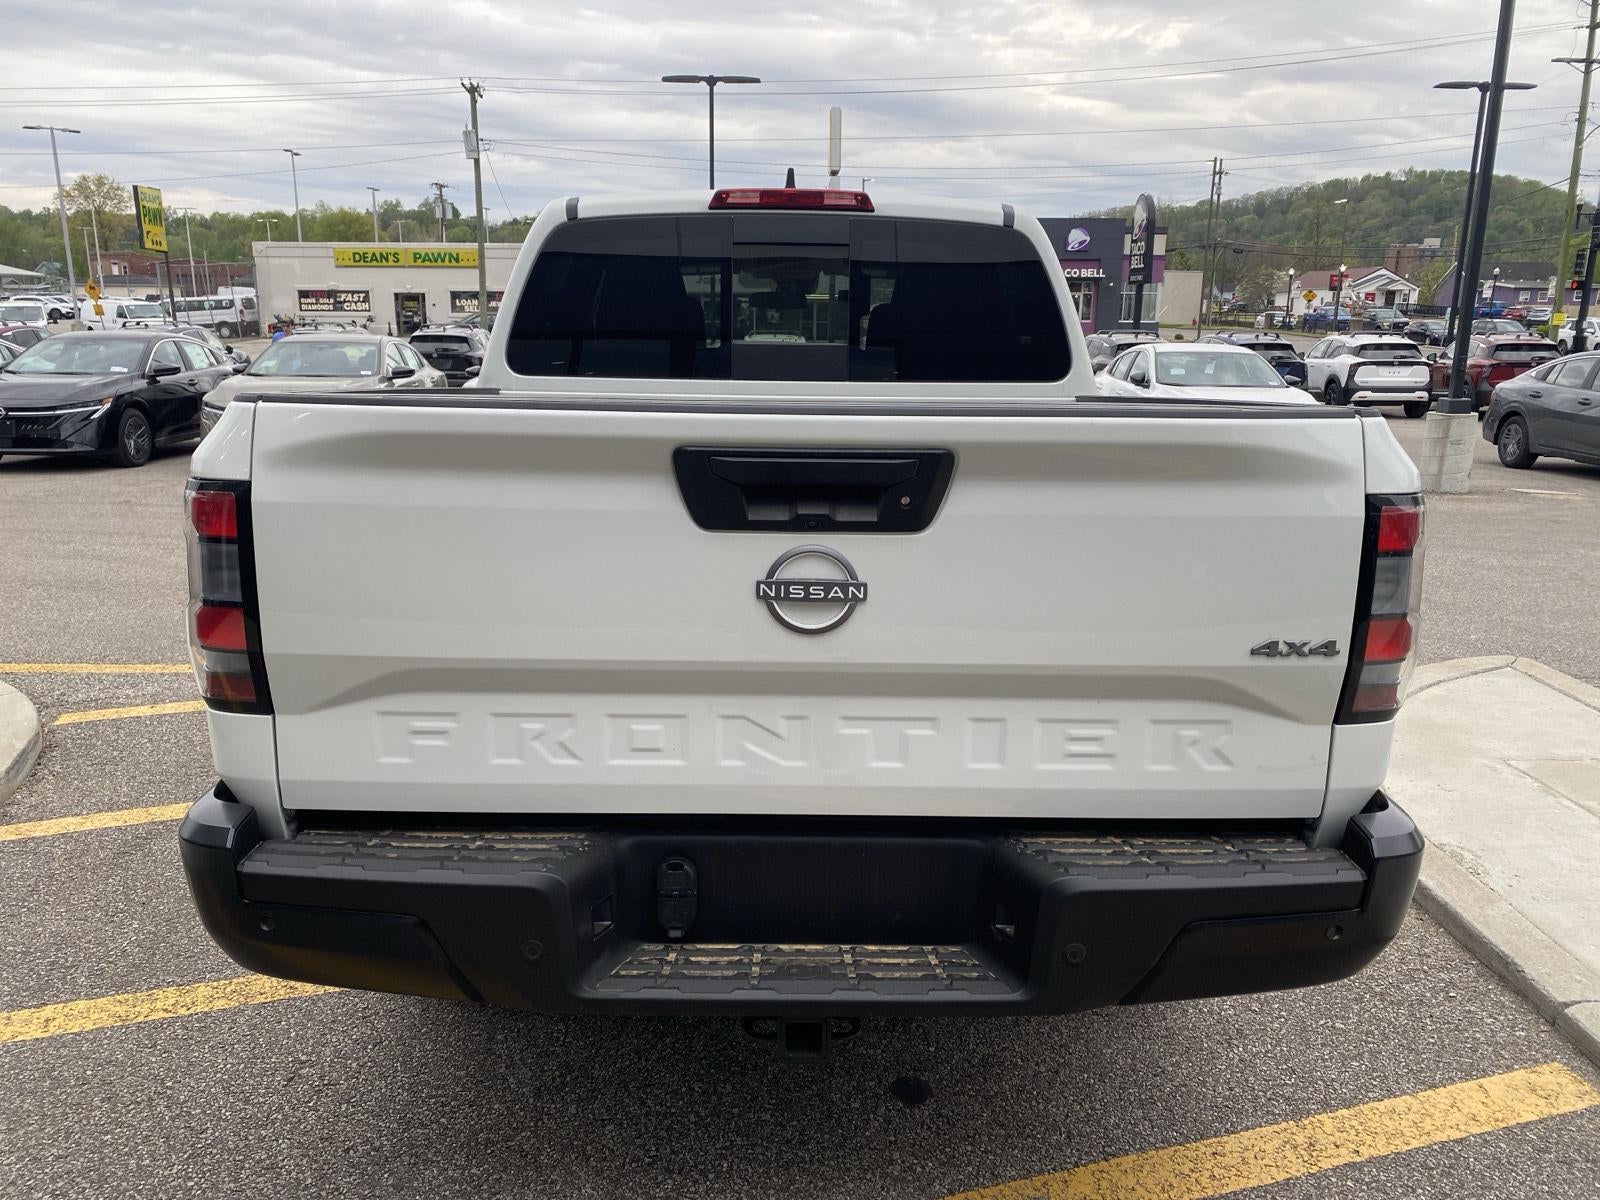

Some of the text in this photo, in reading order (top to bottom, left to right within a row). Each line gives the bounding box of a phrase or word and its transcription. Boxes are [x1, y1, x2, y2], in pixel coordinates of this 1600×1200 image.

[142, 205, 163, 227] PAWN
[1131, 241, 1145, 255] TACO
[352, 252, 460, 263] DEAN'S PAWN
[1130, 255, 1144, 268] BELL
[1064, 268, 1105, 278] CO BELL
[340, 293, 366, 302] FAST
[343, 302, 369, 311] CASH
[759, 583, 865, 599] NISSAN
[1250, 638, 1341, 657] 4X4
[374, 710, 1236, 771] FRONTIER
